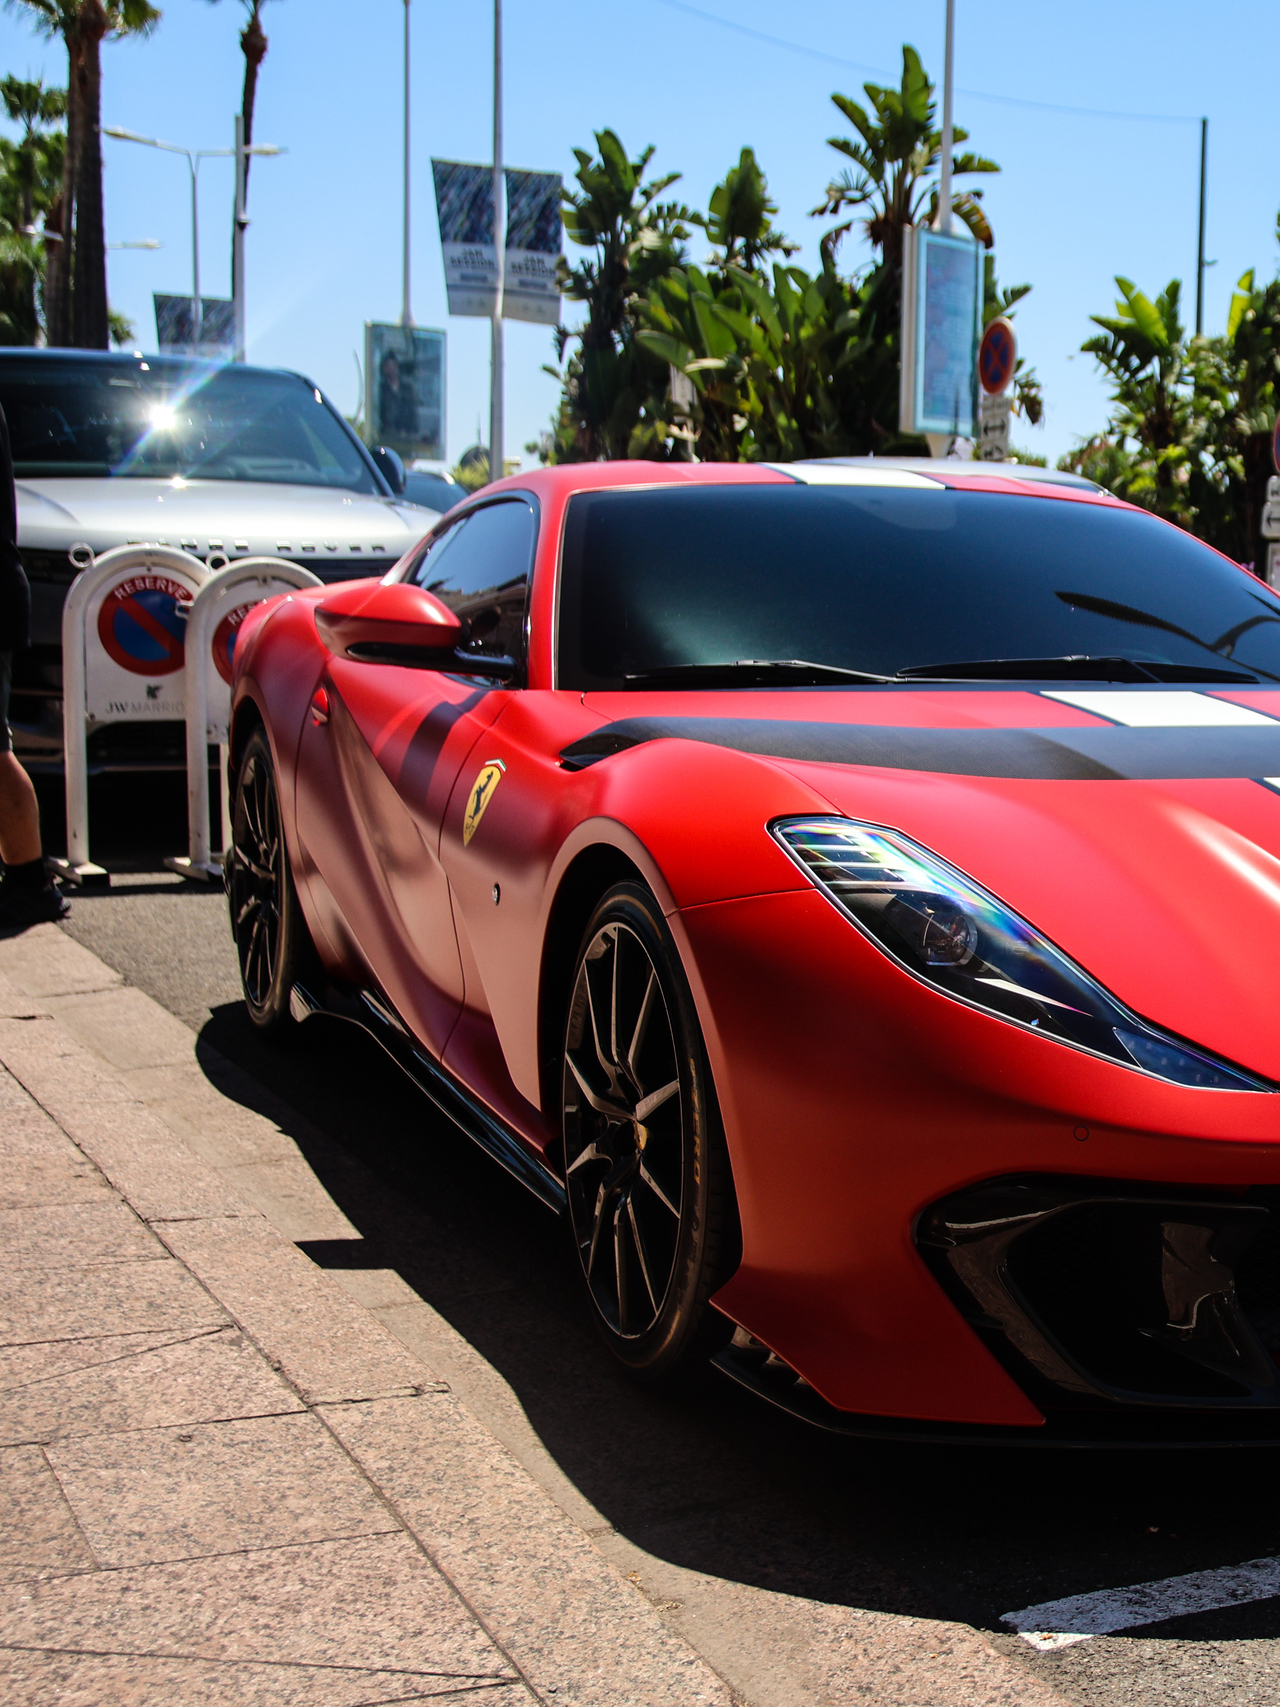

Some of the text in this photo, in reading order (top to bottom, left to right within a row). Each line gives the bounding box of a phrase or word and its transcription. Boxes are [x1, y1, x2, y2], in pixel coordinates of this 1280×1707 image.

[276, 539, 387, 552] ROVER
[114, 576, 188, 601] RESERVE
[106, 702, 127, 714] JW
